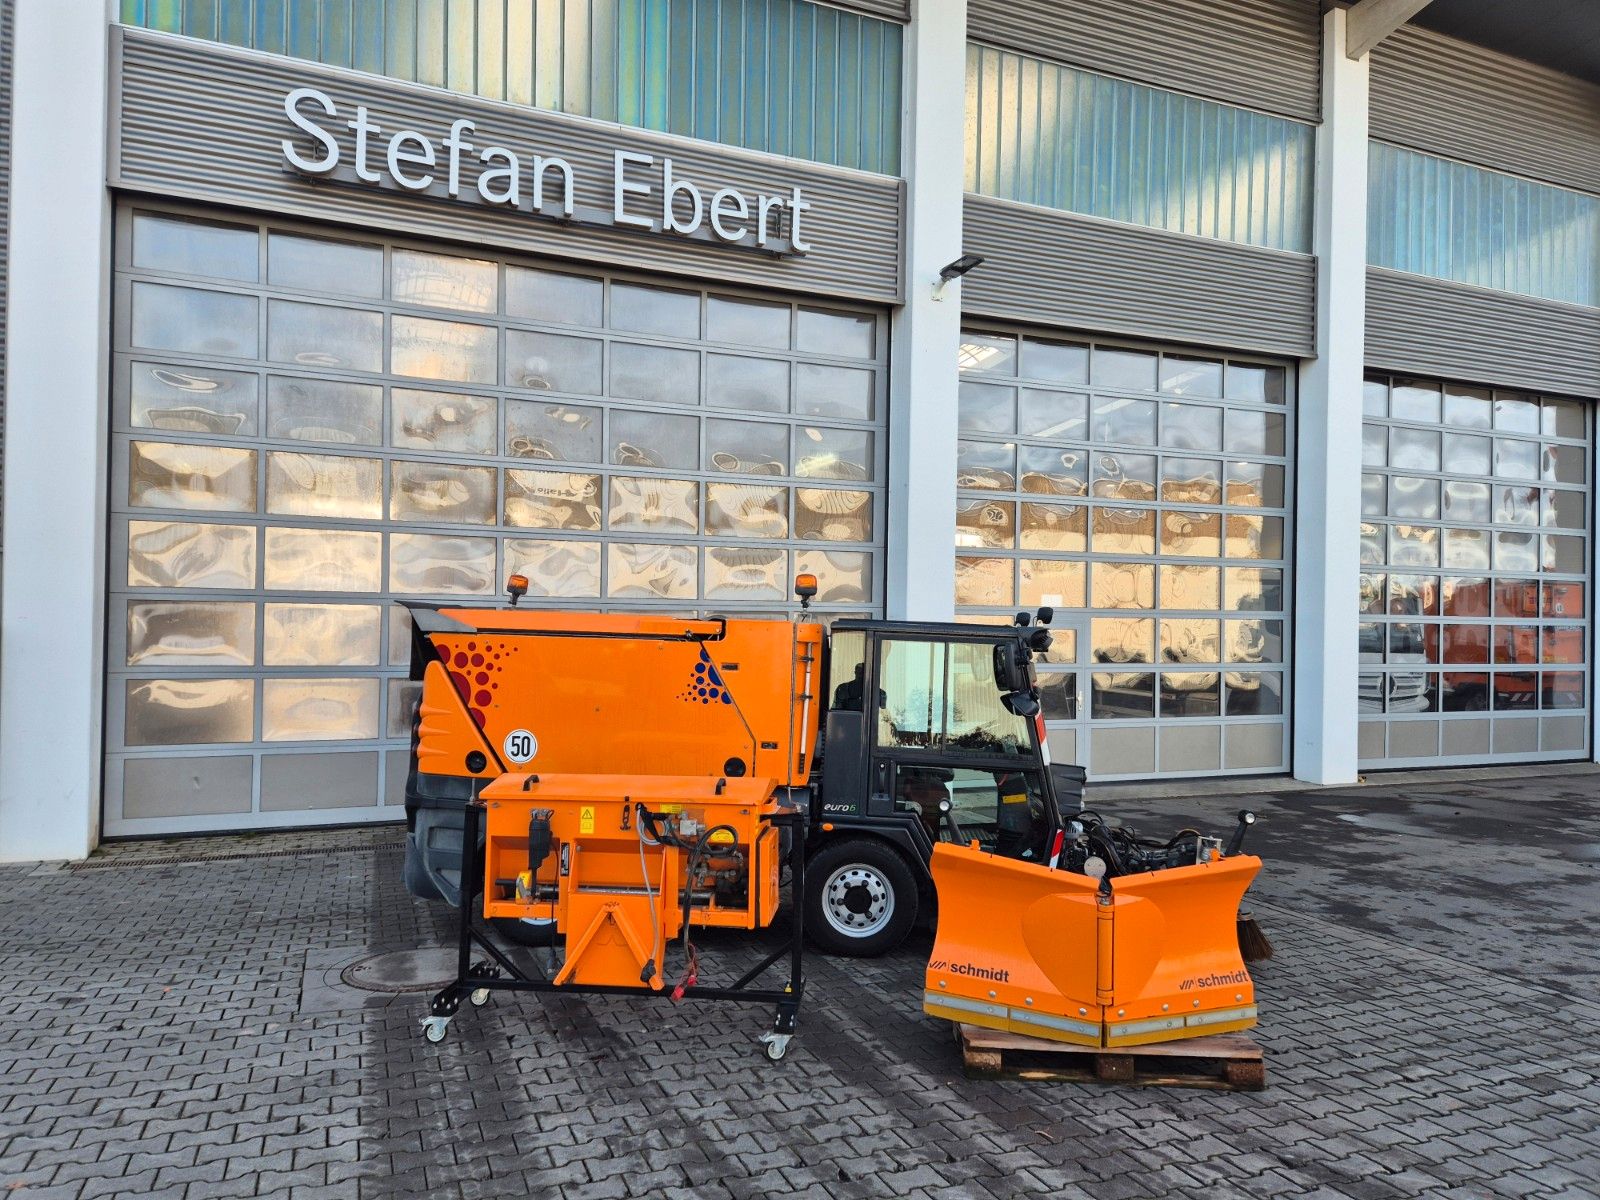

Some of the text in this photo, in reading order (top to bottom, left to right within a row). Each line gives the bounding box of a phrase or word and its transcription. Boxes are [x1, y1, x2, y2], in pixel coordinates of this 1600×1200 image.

[281, 88, 811, 254] Stefan Ebert
[510, 735, 531, 757] 50
[950, 963, 1009, 983] schmidt
[1197, 970, 1249, 988] schmidt
